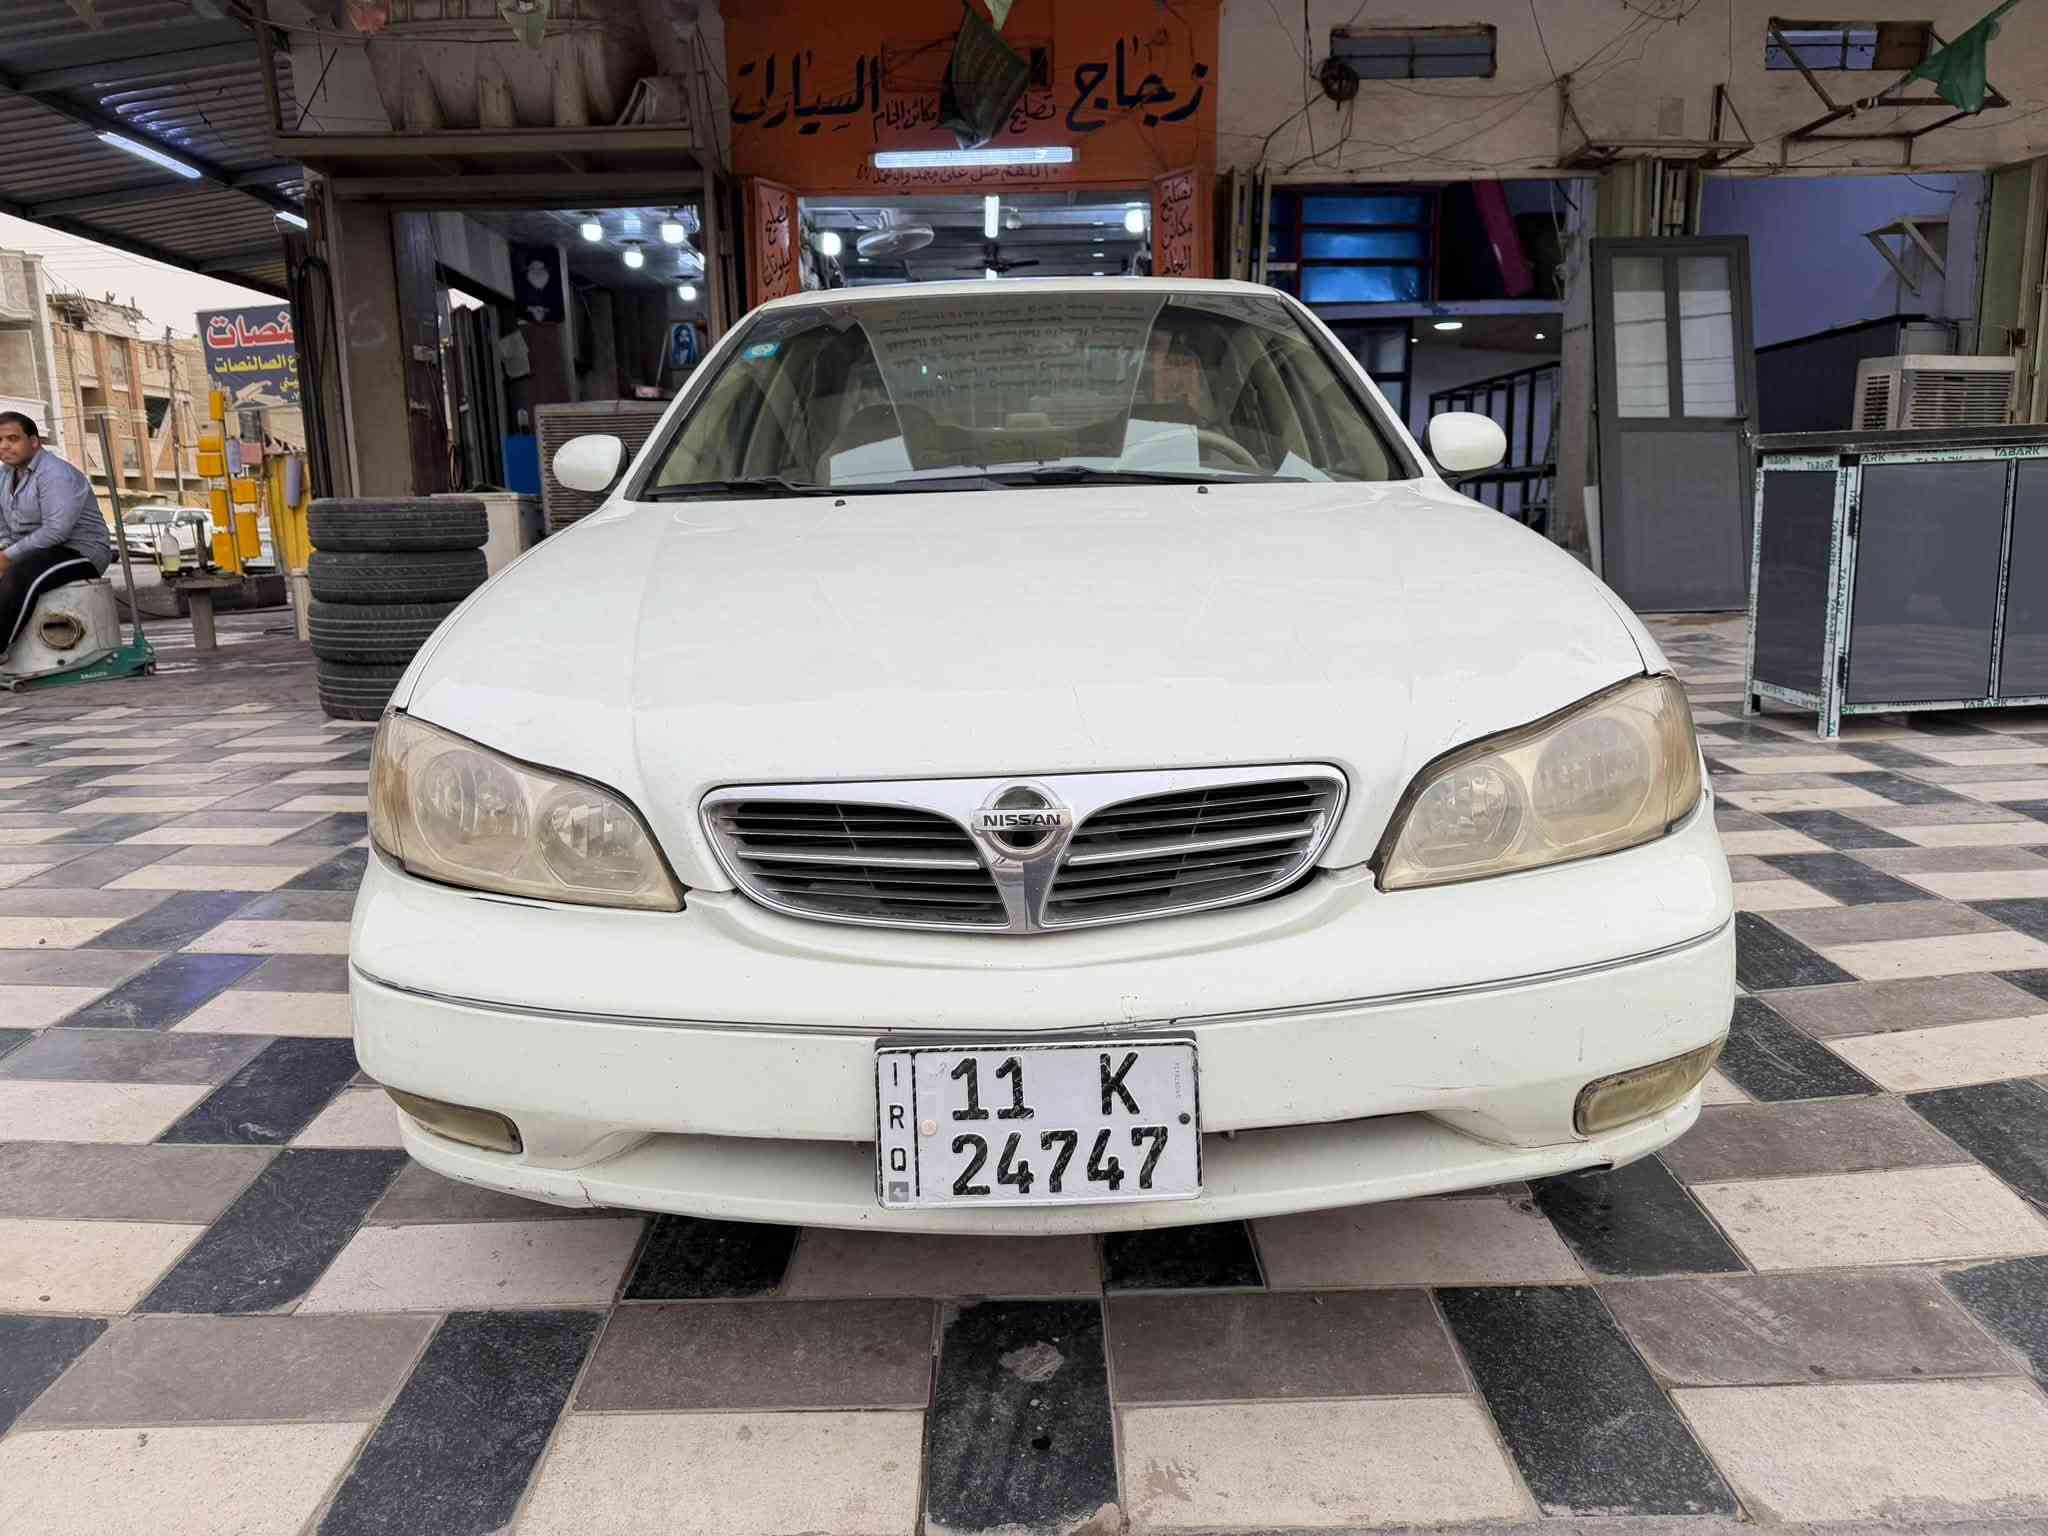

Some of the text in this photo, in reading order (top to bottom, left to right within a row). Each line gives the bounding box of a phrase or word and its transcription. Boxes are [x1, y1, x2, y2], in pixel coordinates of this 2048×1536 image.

[729, 36, 1209, 135] زجاج السيارات
[207, 311, 294, 348] نصات
[1993, 446, 2041, 457] TABARK
[983, 814, 1062, 827] NISSAN
[950, 1056, 1036, 1121] 11
[1099, 1052, 1141, 1116] K
[951, 1124, 1169, 1196] 24747
